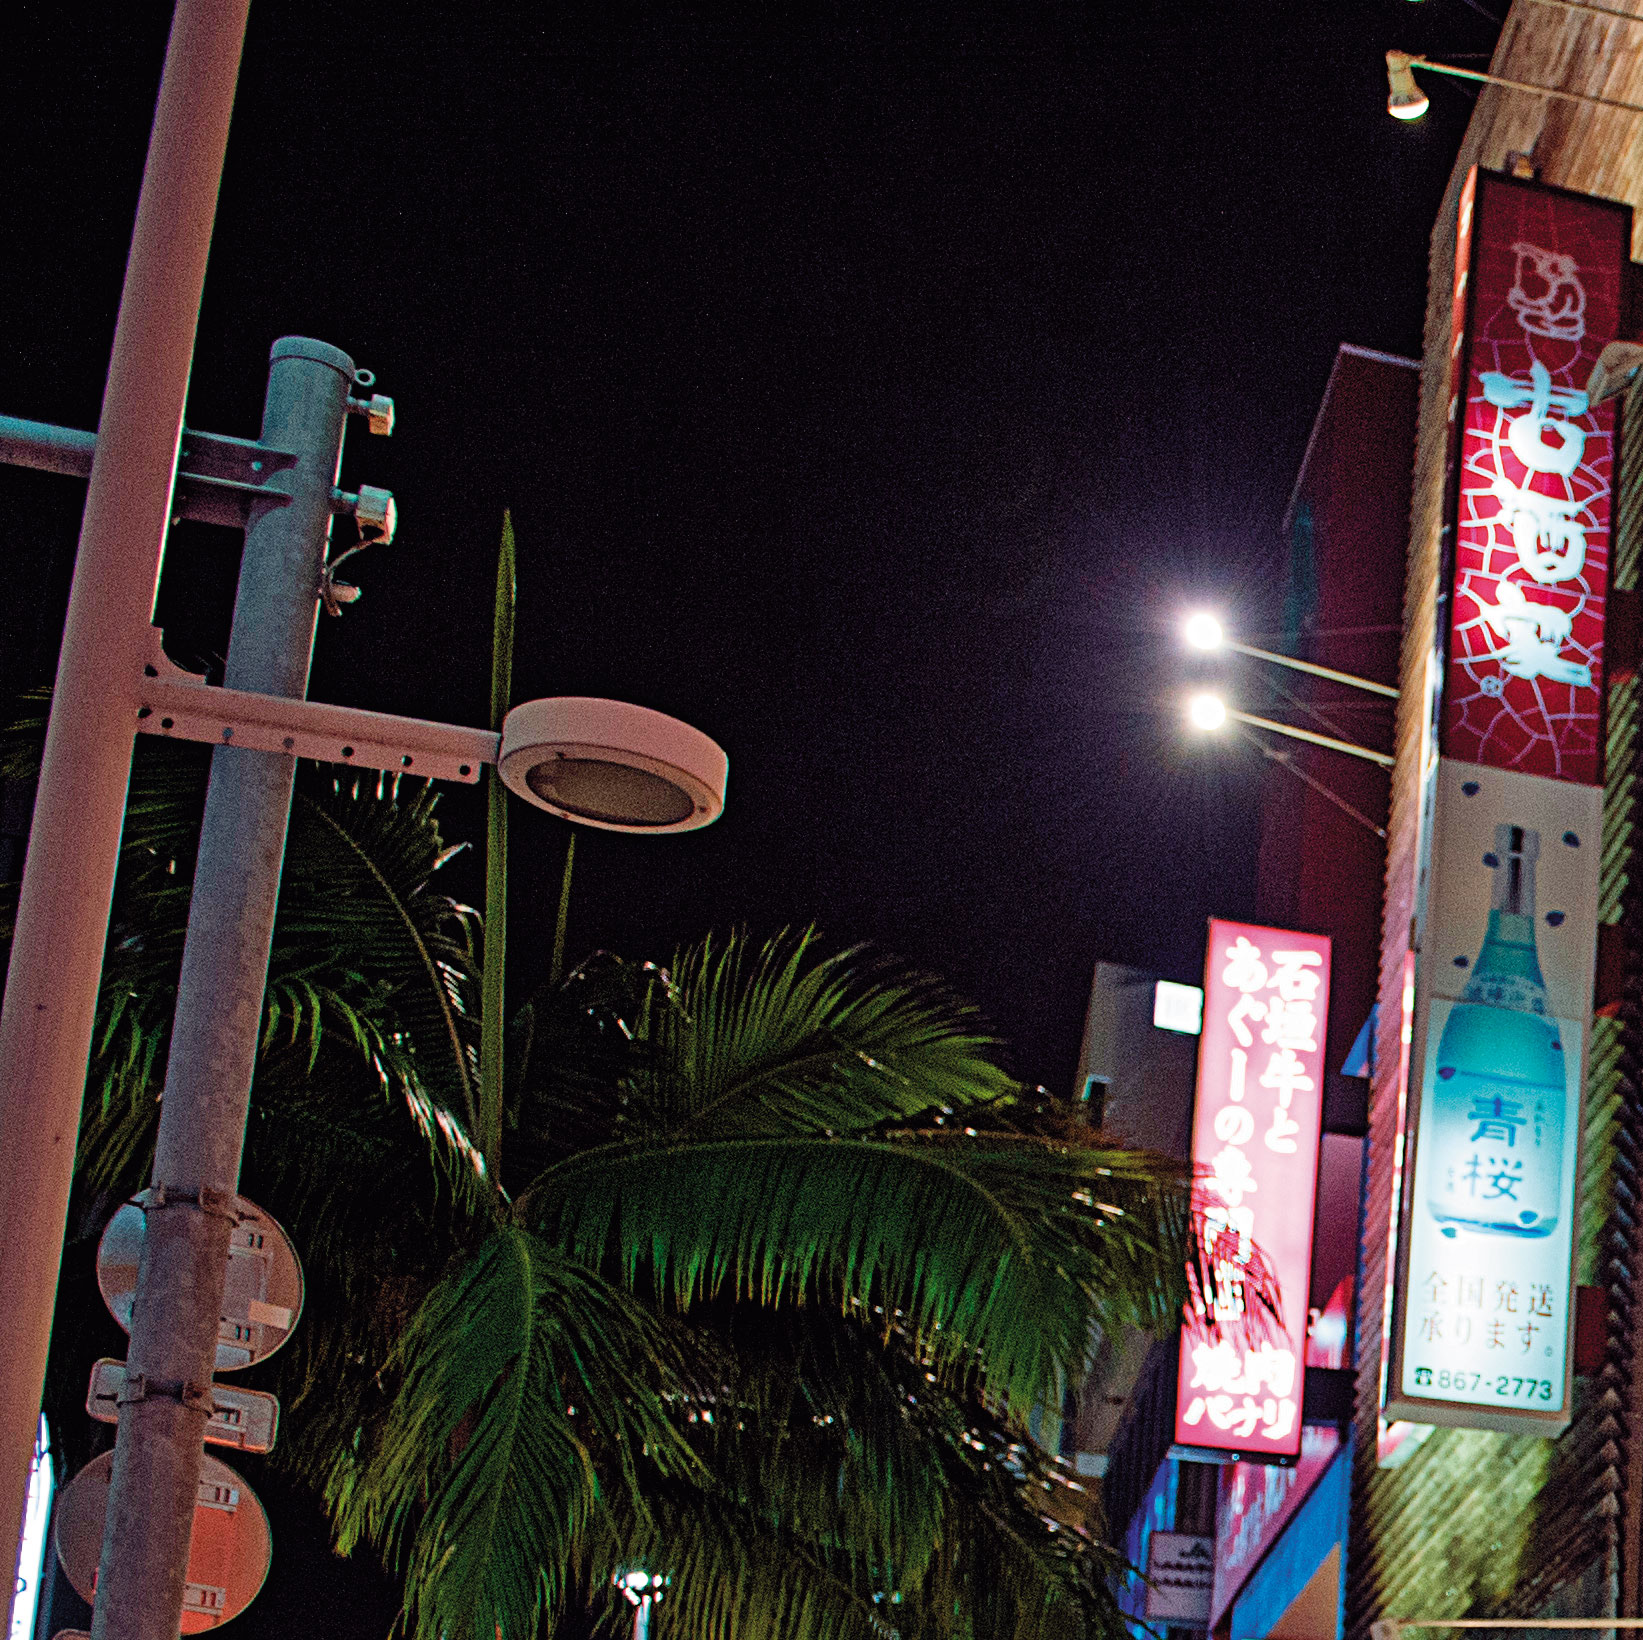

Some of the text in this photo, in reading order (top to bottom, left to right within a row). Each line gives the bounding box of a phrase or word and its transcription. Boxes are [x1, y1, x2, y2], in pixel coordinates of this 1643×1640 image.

[1464, 1096, 1527, 1202] 青桜
[1422, 1270, 1553, 1318] 全国発送
[1438, 1369, 1553, 1401] 867-2773
